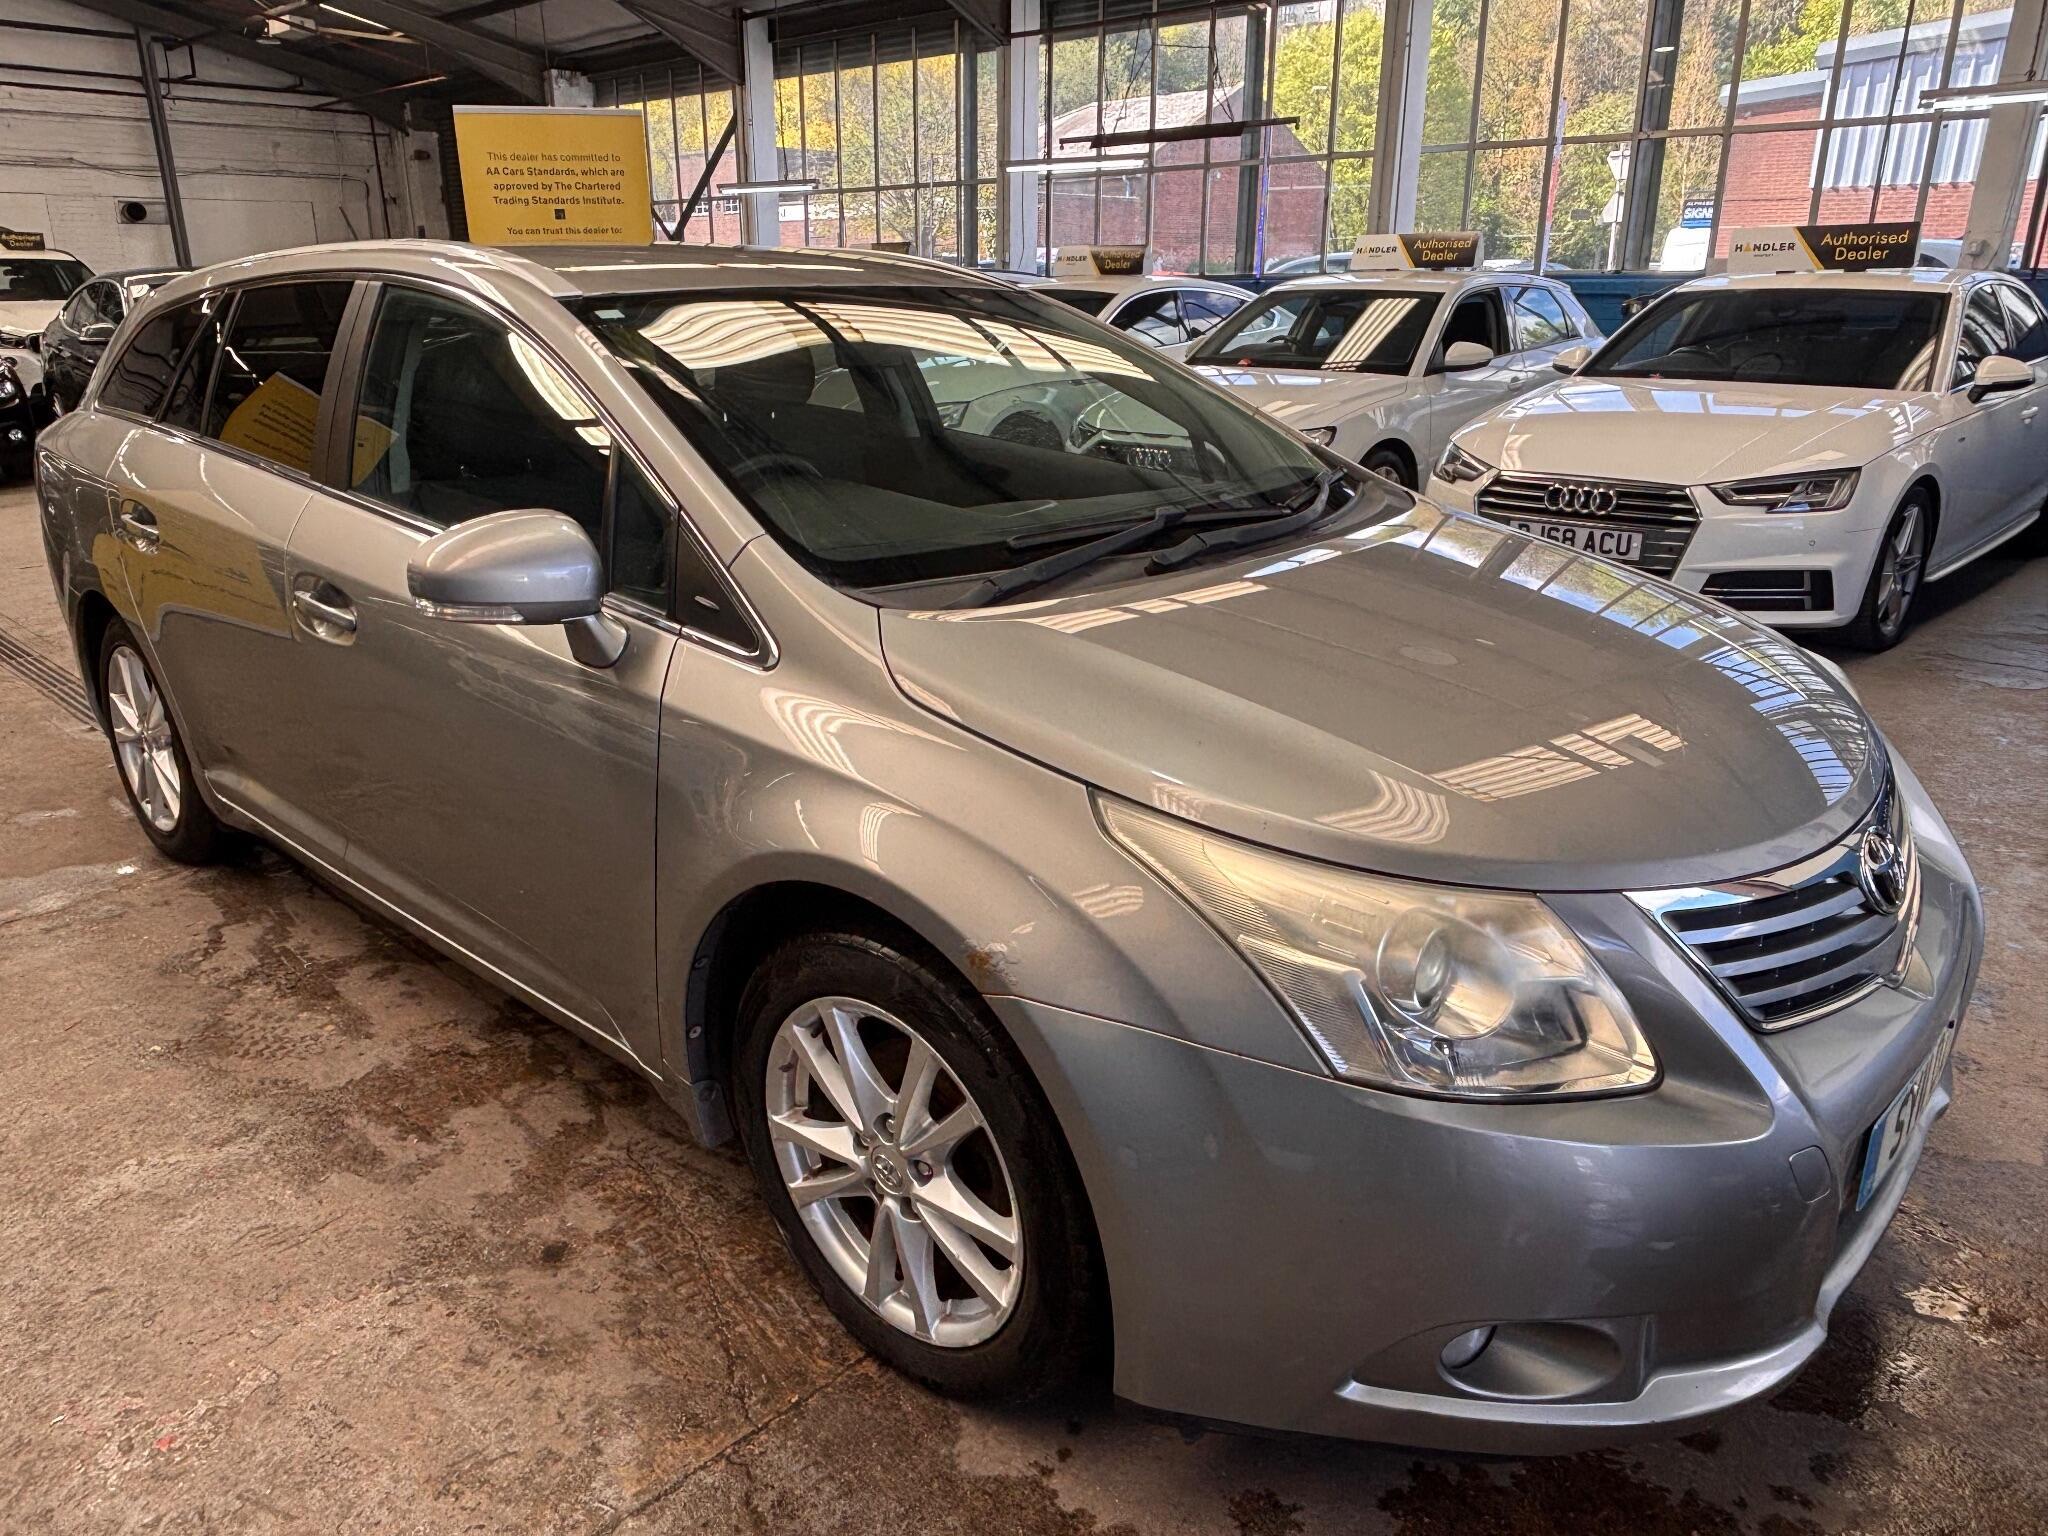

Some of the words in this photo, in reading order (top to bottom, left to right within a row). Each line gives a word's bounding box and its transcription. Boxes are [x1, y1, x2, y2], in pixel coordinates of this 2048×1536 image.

[486, 152, 508, 161] This
[510, 152, 538, 161] dealer
[541, 152, 558, 161] has
[560, 152, 609, 162] committed
[611, 153, 621, 162] to
[486, 167, 500, 176] AA
[502, 167, 525, 176] Cars
[527, 167, 579, 177] Standards,
[580, 167, 609, 176] which
[493, 182, 539, 191] approved
[541, 182, 553, 192] by
[554, 182, 572, 191] The
[574, 182, 621, 191] Chartered
[493, 196, 530, 206] Trading
[531, 196, 580, 205] Standards
[582, 196, 624, 205] Institute.
[507, 227, 523, 235] You
[525, 227, 541, 235] can
[542, 227, 563, 235] trust
[565, 226, 581, 235] this
[583, 226, 609, 235] dealer
[610, 226, 623, 235] to:
[1821, 229, 1910, 246] Authorised
[1414, 239, 1472, 249] Authorised
[1422, 249, 1459, 261] Dealer
[1834, 246, 1889, 261] Dealer
[1104, 260, 1130, 269] Dealer
[1582, 530, 1633, 557] ACU
